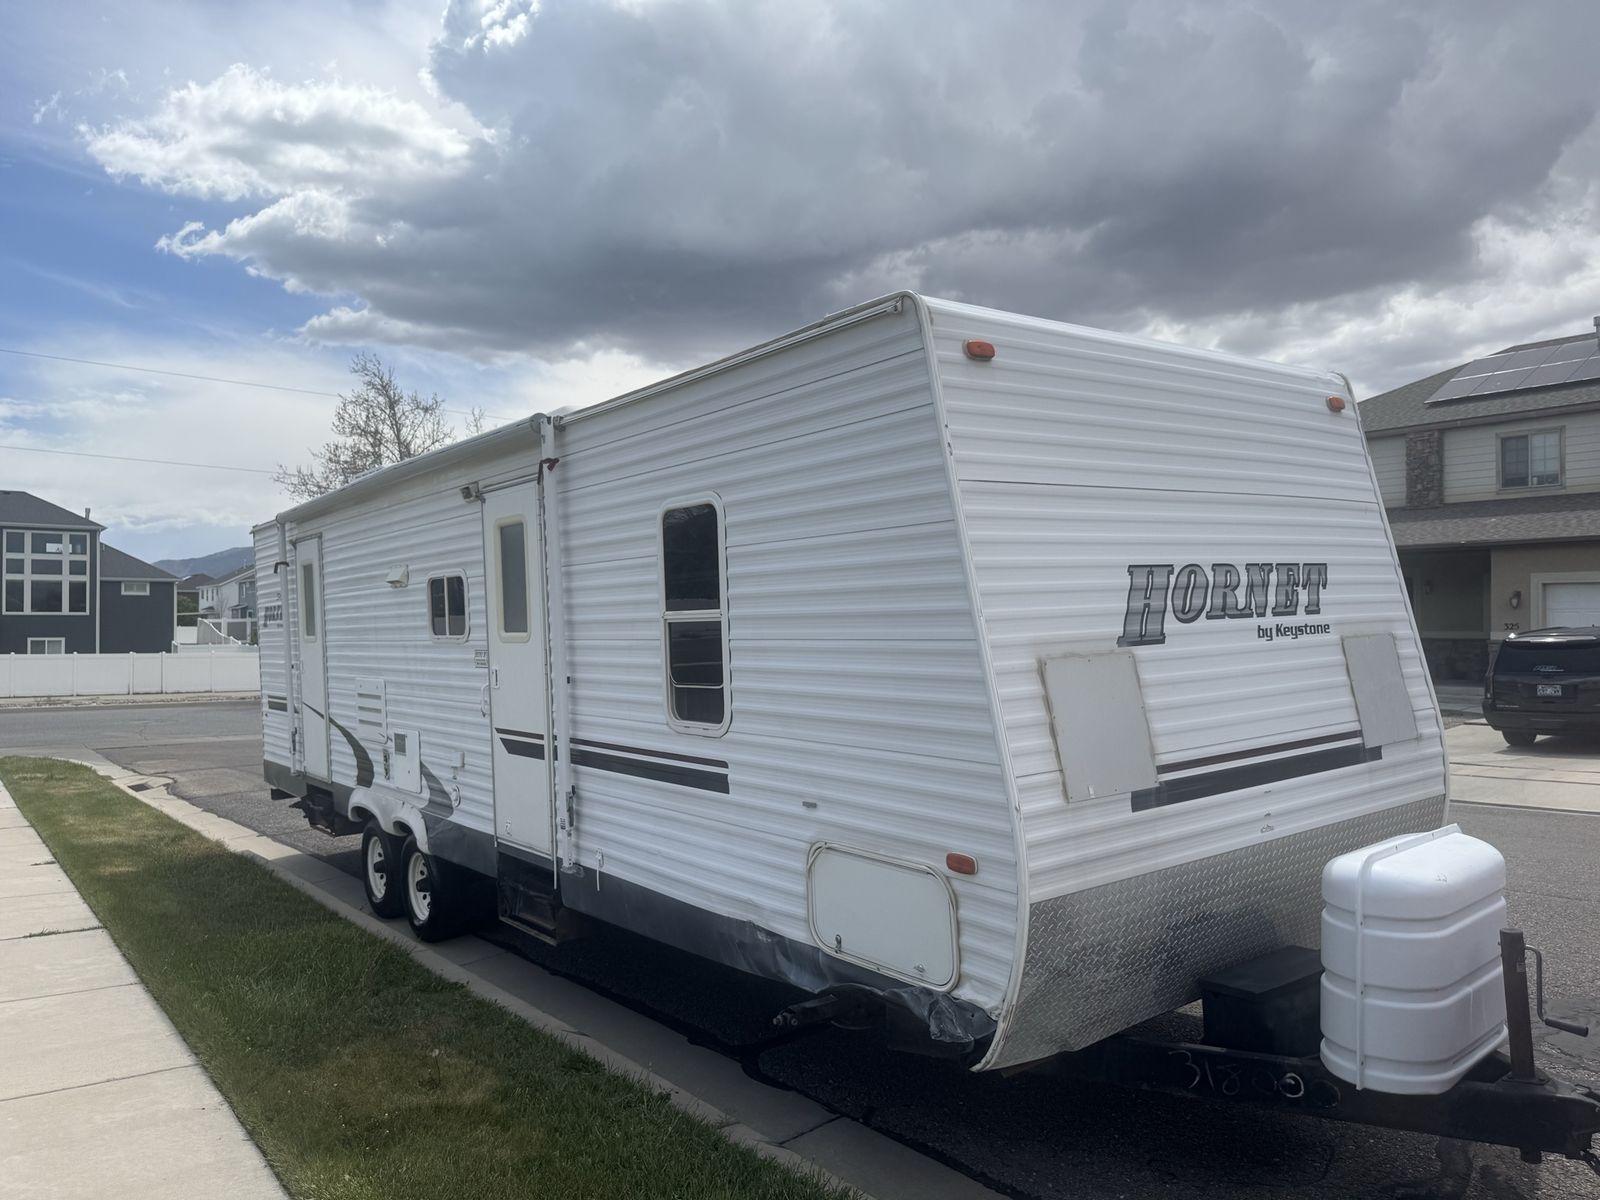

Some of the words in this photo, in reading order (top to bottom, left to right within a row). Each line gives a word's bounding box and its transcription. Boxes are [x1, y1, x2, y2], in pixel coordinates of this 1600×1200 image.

[1116, 563, 1328, 647] HORNET
[1257, 625, 1273, 641] by
[1275, 623, 1331, 640] Keystone
